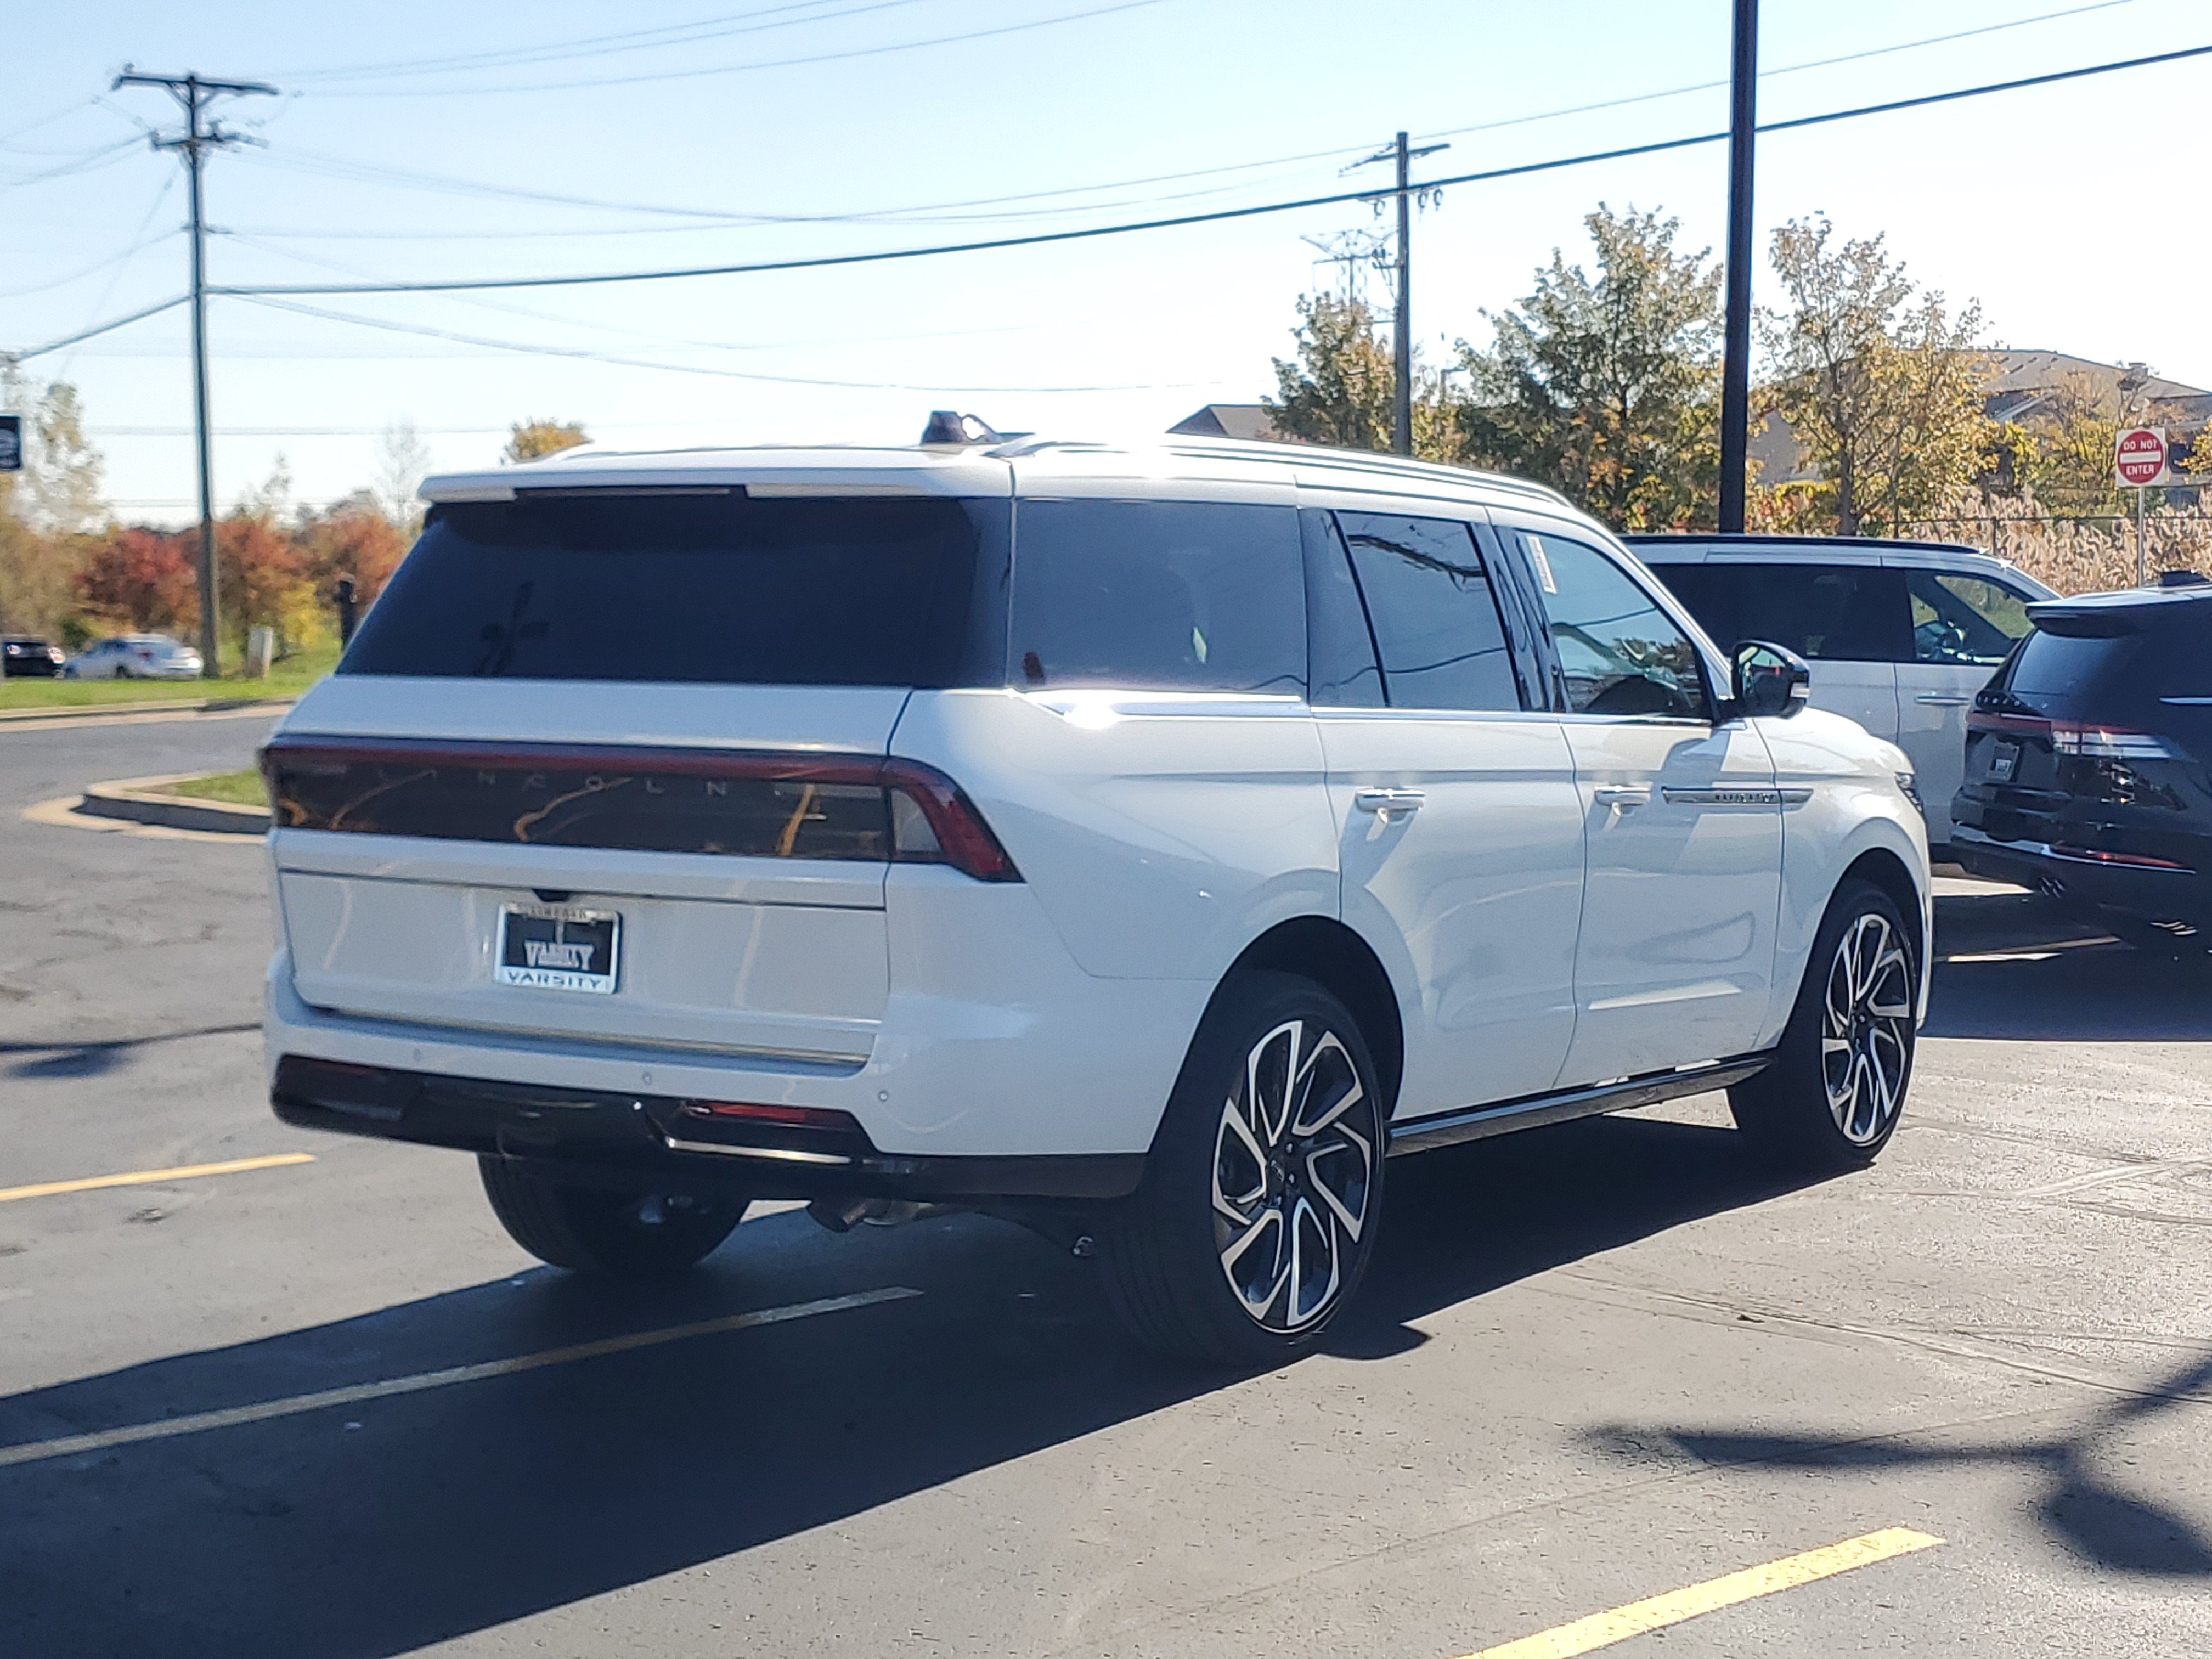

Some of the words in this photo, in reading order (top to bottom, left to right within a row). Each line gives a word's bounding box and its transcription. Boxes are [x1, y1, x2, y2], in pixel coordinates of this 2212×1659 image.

[2123, 440, 2136, 450] DO
[2140, 439, 2157, 449] NOT
[2126, 464, 2154, 476] ENTER
[508, 970, 601, 989] VARSITY
